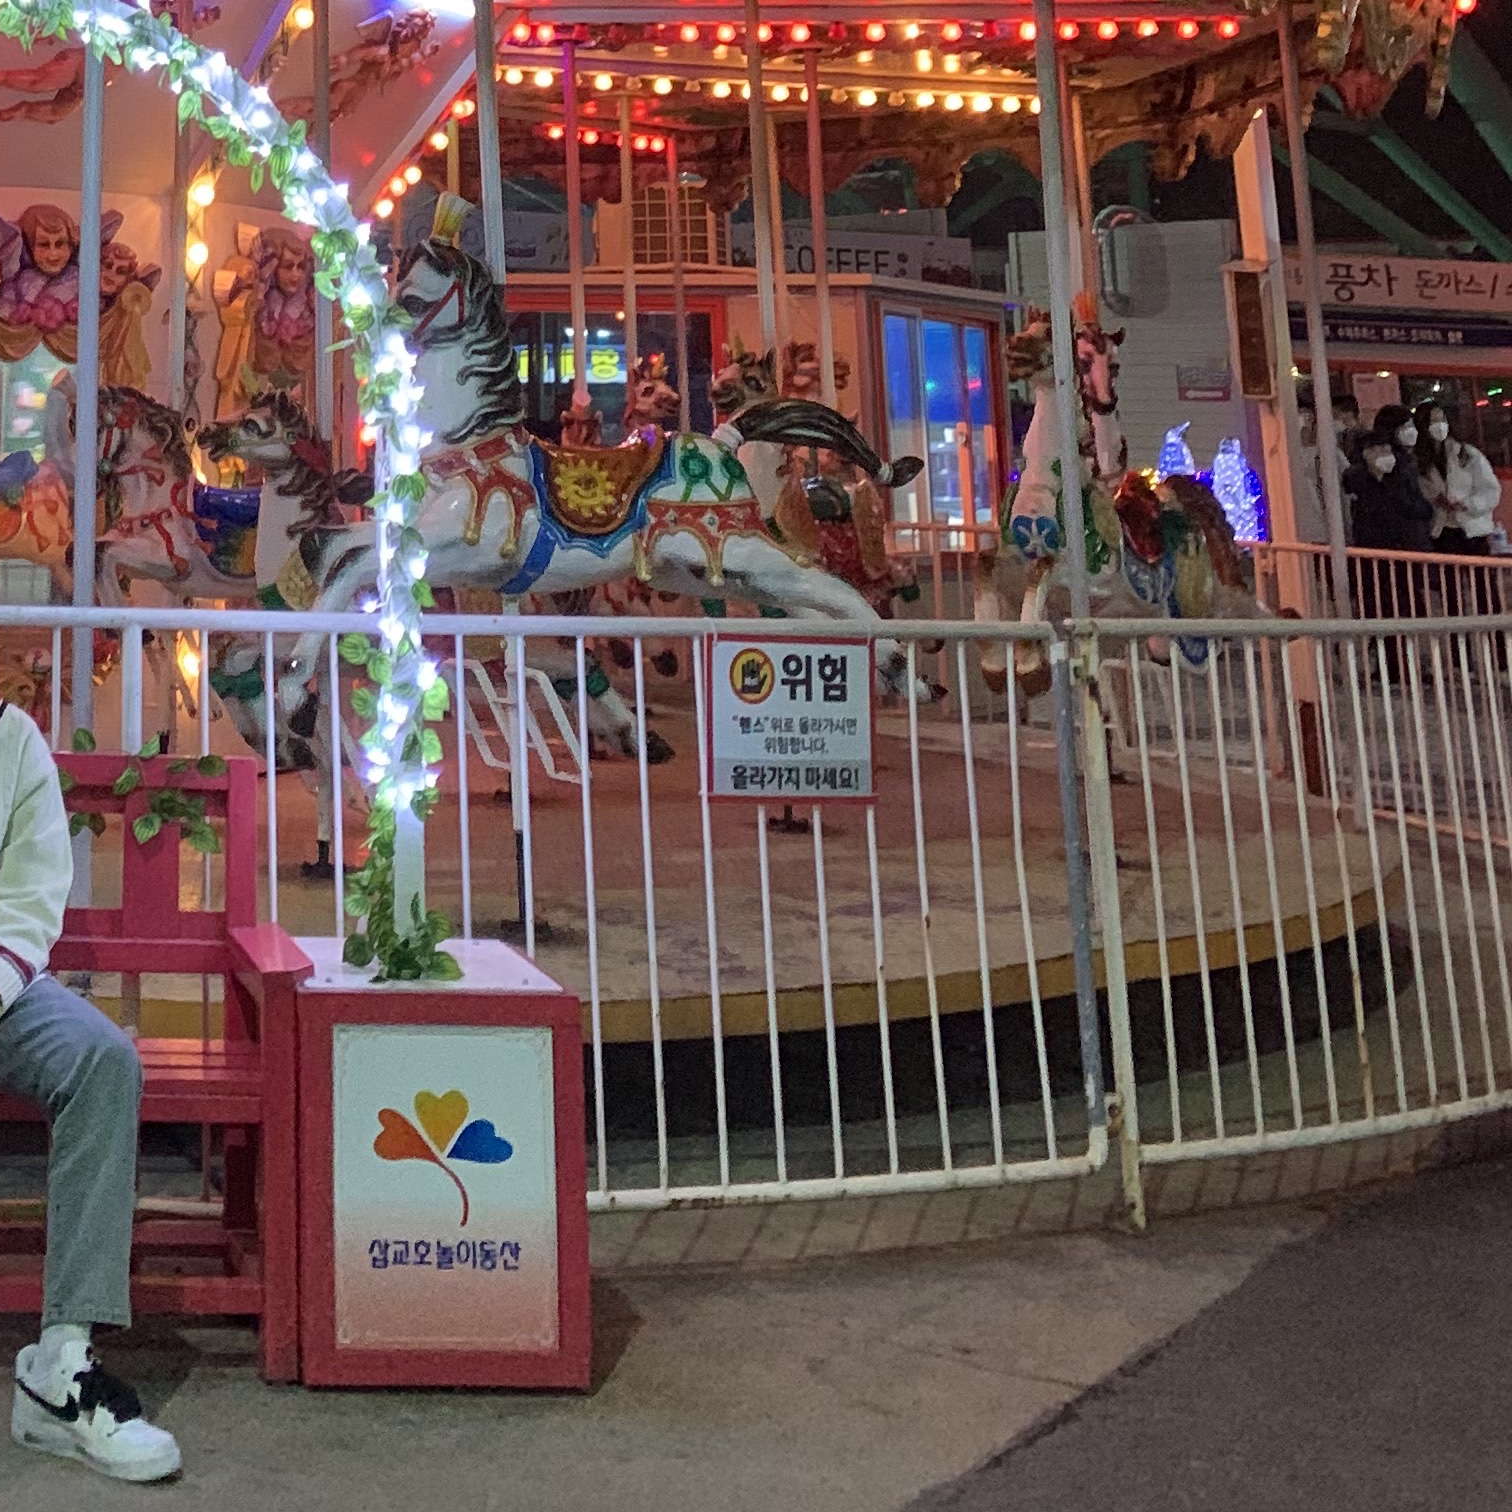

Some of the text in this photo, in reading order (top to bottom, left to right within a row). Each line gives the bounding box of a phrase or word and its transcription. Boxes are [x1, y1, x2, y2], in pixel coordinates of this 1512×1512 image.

[1326, 262, 1399, 302] 풍차
[781, 654, 848, 702] 위험
[731, 765, 859, 791] 올라가지 마세요!
